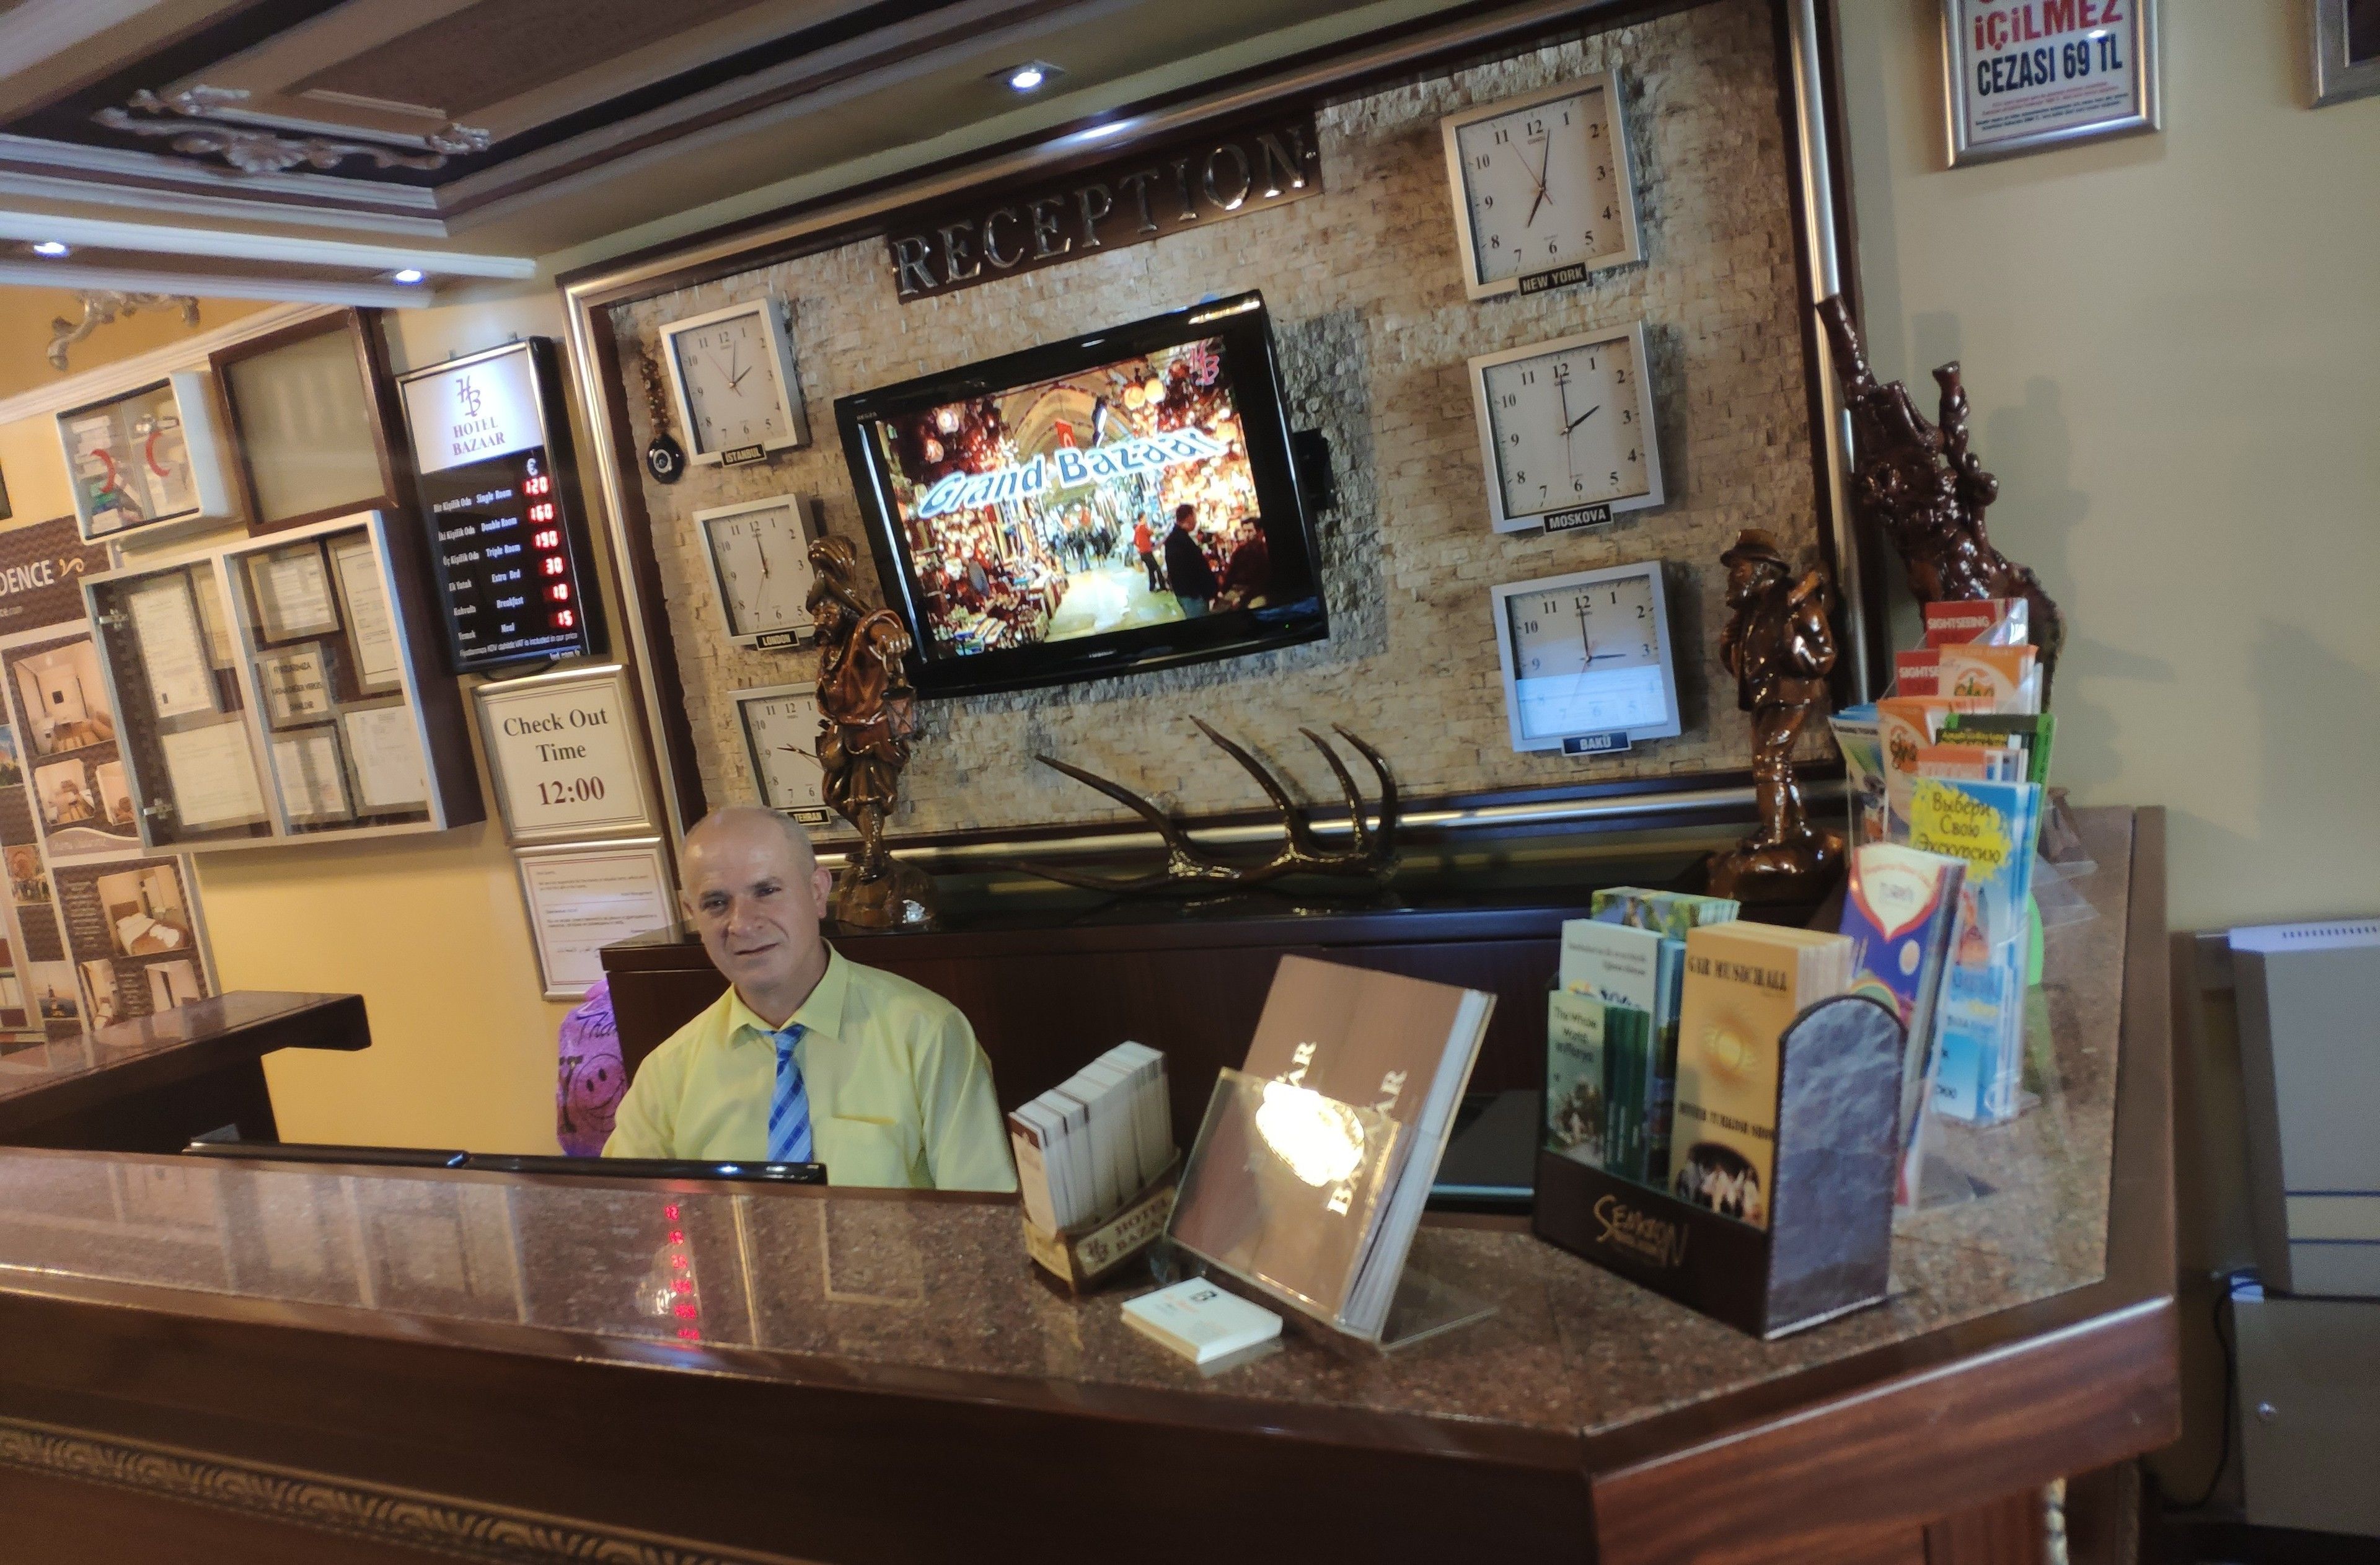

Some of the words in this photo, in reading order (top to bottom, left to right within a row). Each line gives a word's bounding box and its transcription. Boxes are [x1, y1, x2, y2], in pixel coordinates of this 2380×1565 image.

[1977, 46, 2056, 96] CEZASI
[2063, 40, 2090, 79] 69
[2098, 33, 2123, 72] TL
[1562, 112, 1570, 125] 1
[1527, 120, 1543, 136] 12
[1590, 124, 1600, 138] 2
[1494, 129, 1509, 144] 11
[1475, 154, 1490, 169] 10
[1597, 165, 1605, 180] 3
[1485, 195, 1493, 209] 9
[892, 128, 1307, 295] RECEPTION
[1602, 206, 1611, 219] 4
[1491, 234, 1500, 248] 8
[1585, 231, 1593, 245] 5
[1549, 240, 1558, 253] 6
[1514, 249, 1522, 262] 7
[1523, 275, 1549, 292] NEW
[1551, 268, 1583, 284] YORK
[699, 337, 708, 348] 11
[719, 331, 729, 343] 12
[760, 338, 766, 348] 2
[687, 355, 698, 366] 10
[1589, 357, 1596, 369] 1
[1553, 363, 1569, 379] 12
[1616, 369, 1625, 383] 2
[1522, 371, 1535, 385] 11
[697, 387, 703, 397] 9
[1501, 394, 1517, 408] 10
[705, 417, 712, 427] 8
[1623, 410, 1631, 425] 3
[453, 416, 498, 438] HOTEL
[721, 428, 726, 438] 7
[743, 424, 749, 434] 6
[452, 432, 506, 456] BAZAAR
[1510, 434, 1519, 446] 9
[1628, 448, 1636, 461] 4
[919, 453, 1046, 519] Grand
[1055, 427, 1227, 488] Bazaar
[1517, 471, 1525, 484] 8
[1610, 472, 1619, 485] 5
[476, 492, 493, 504] Single
[495, 489, 513, 500] Room
[525, 477, 549, 495] 120
[1574, 478, 1582, 492] 6
[1540, 485, 1548, 499] 7
[481, 521, 500, 532] Double
[501, 518, 518, 527] Room
[531, 503, 554, 521] 160
[771, 518, 775, 527] 1
[1549, 509, 1606, 529] MOSKOVA
[731, 525, 740, 536] 11
[789, 529, 796, 539] 2
[486, 547, 503, 558] Triple
[505, 544, 521, 553] Room
[535, 531, 558, 547] 190
[721, 540, 731, 552] 10
[491, 574, 507, 583] Extra
[509, 569, 521, 579] Bed
[546, 557, 563, 575] 30
[798, 560, 804, 570] 3
[731, 571, 737, 581] 9
[496, 596, 524, 609] Breakfast
[553, 584, 568, 599] 10
[1610, 592, 1617, 604] 1
[738, 599, 745, 610] 8
[1543, 601, 1557, 614] 11
[1575, 596, 1591, 611] 12
[754, 612, 760, 621] 7
[776, 610, 782, 619] 6
[797, 606, 803, 616] 5
[1636, 605, 1646, 619] 2
[558, 610, 573, 626] 15
[1927, 616, 1990, 630] SIGHTSEEING
[1523, 620, 1538, 634] 10
[1642, 644, 1650, 657] 3
[1532, 658, 1540, 670] 9
[766, 705, 776, 715] 11
[785, 703, 796, 713] 12
[807, 701, 812, 711] 1
[503, 713, 564, 736] Check
[570, 707, 609, 729] Out
[756, 720, 765, 730] 10
[536, 743, 586, 763] Time
[765, 749, 771, 758] 9
[773, 776, 779, 786] 8
[537, 775, 605, 806] 12:00
[787, 788, 793, 798] 7
[809, 787, 815, 797] 6
